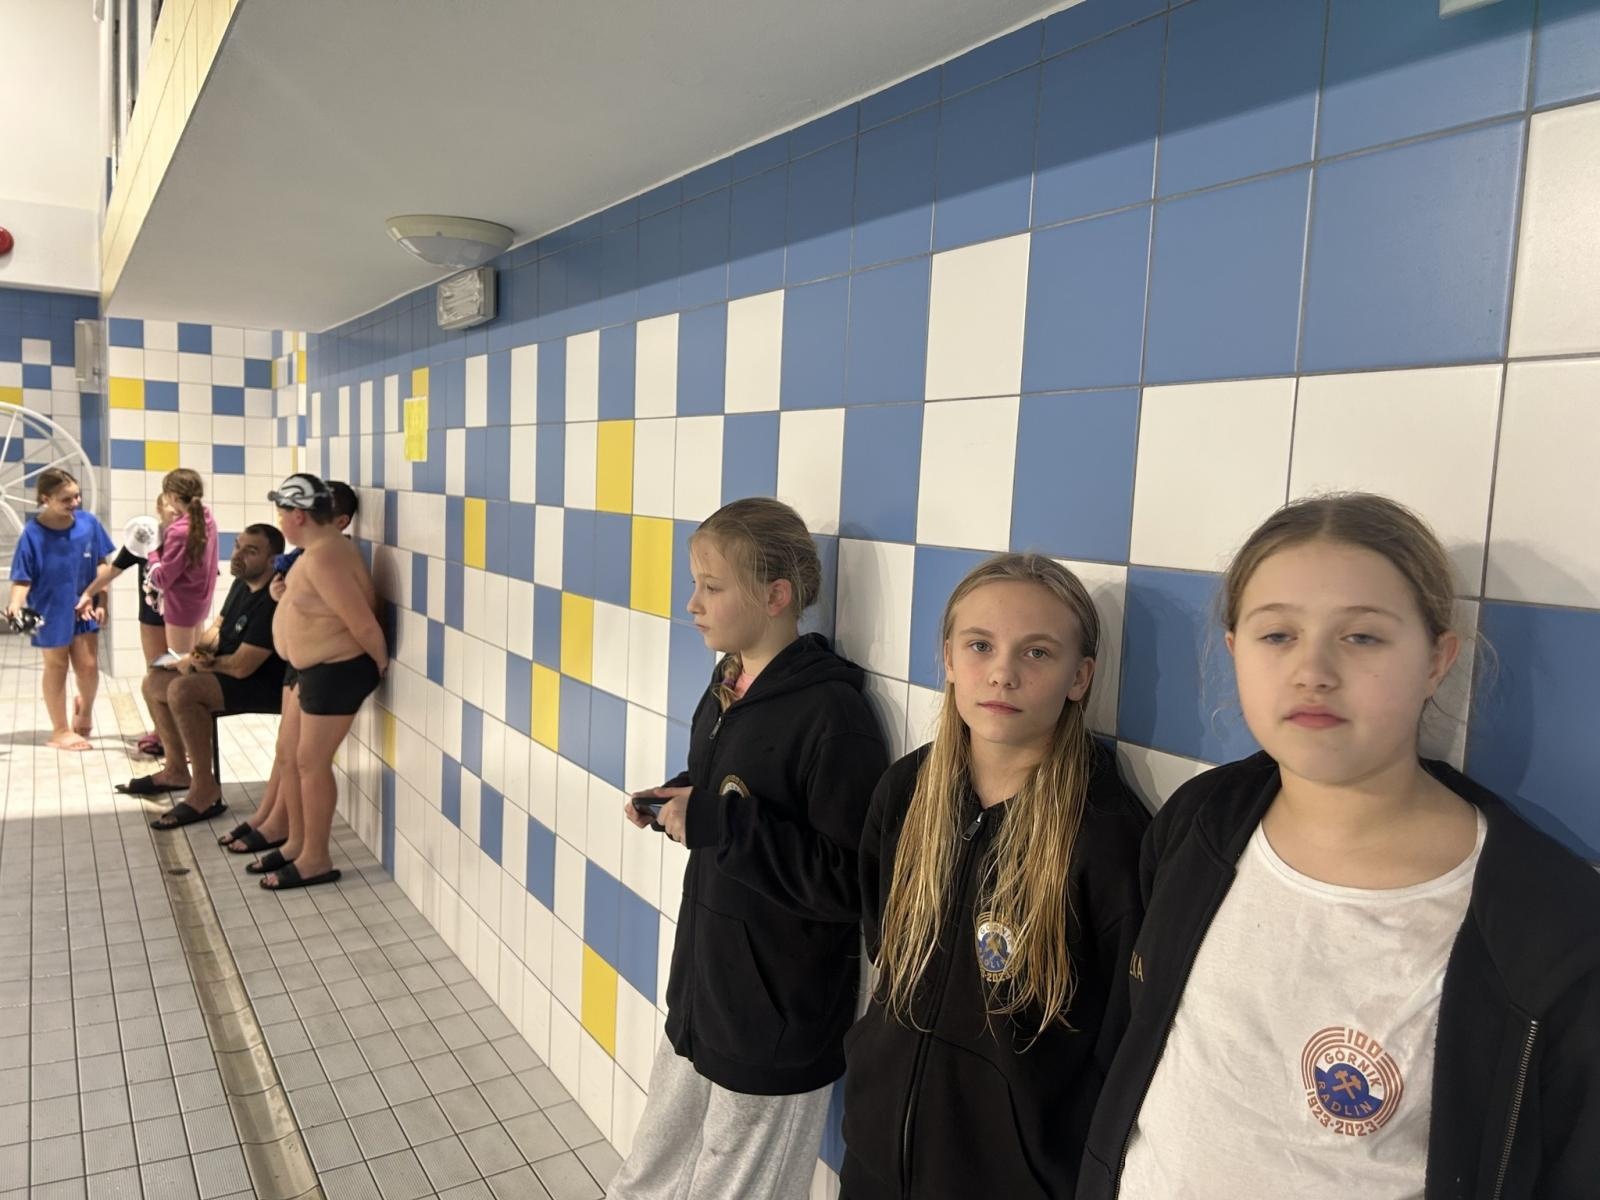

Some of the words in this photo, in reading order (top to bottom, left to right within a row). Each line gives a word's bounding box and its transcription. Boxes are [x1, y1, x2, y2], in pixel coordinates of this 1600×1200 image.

[1347, 1028, 1383, 1059] 100
[1324, 1048, 1382, 1087] GÓRNIK
[1317, 1081, 1373, 1116] RADLIN
